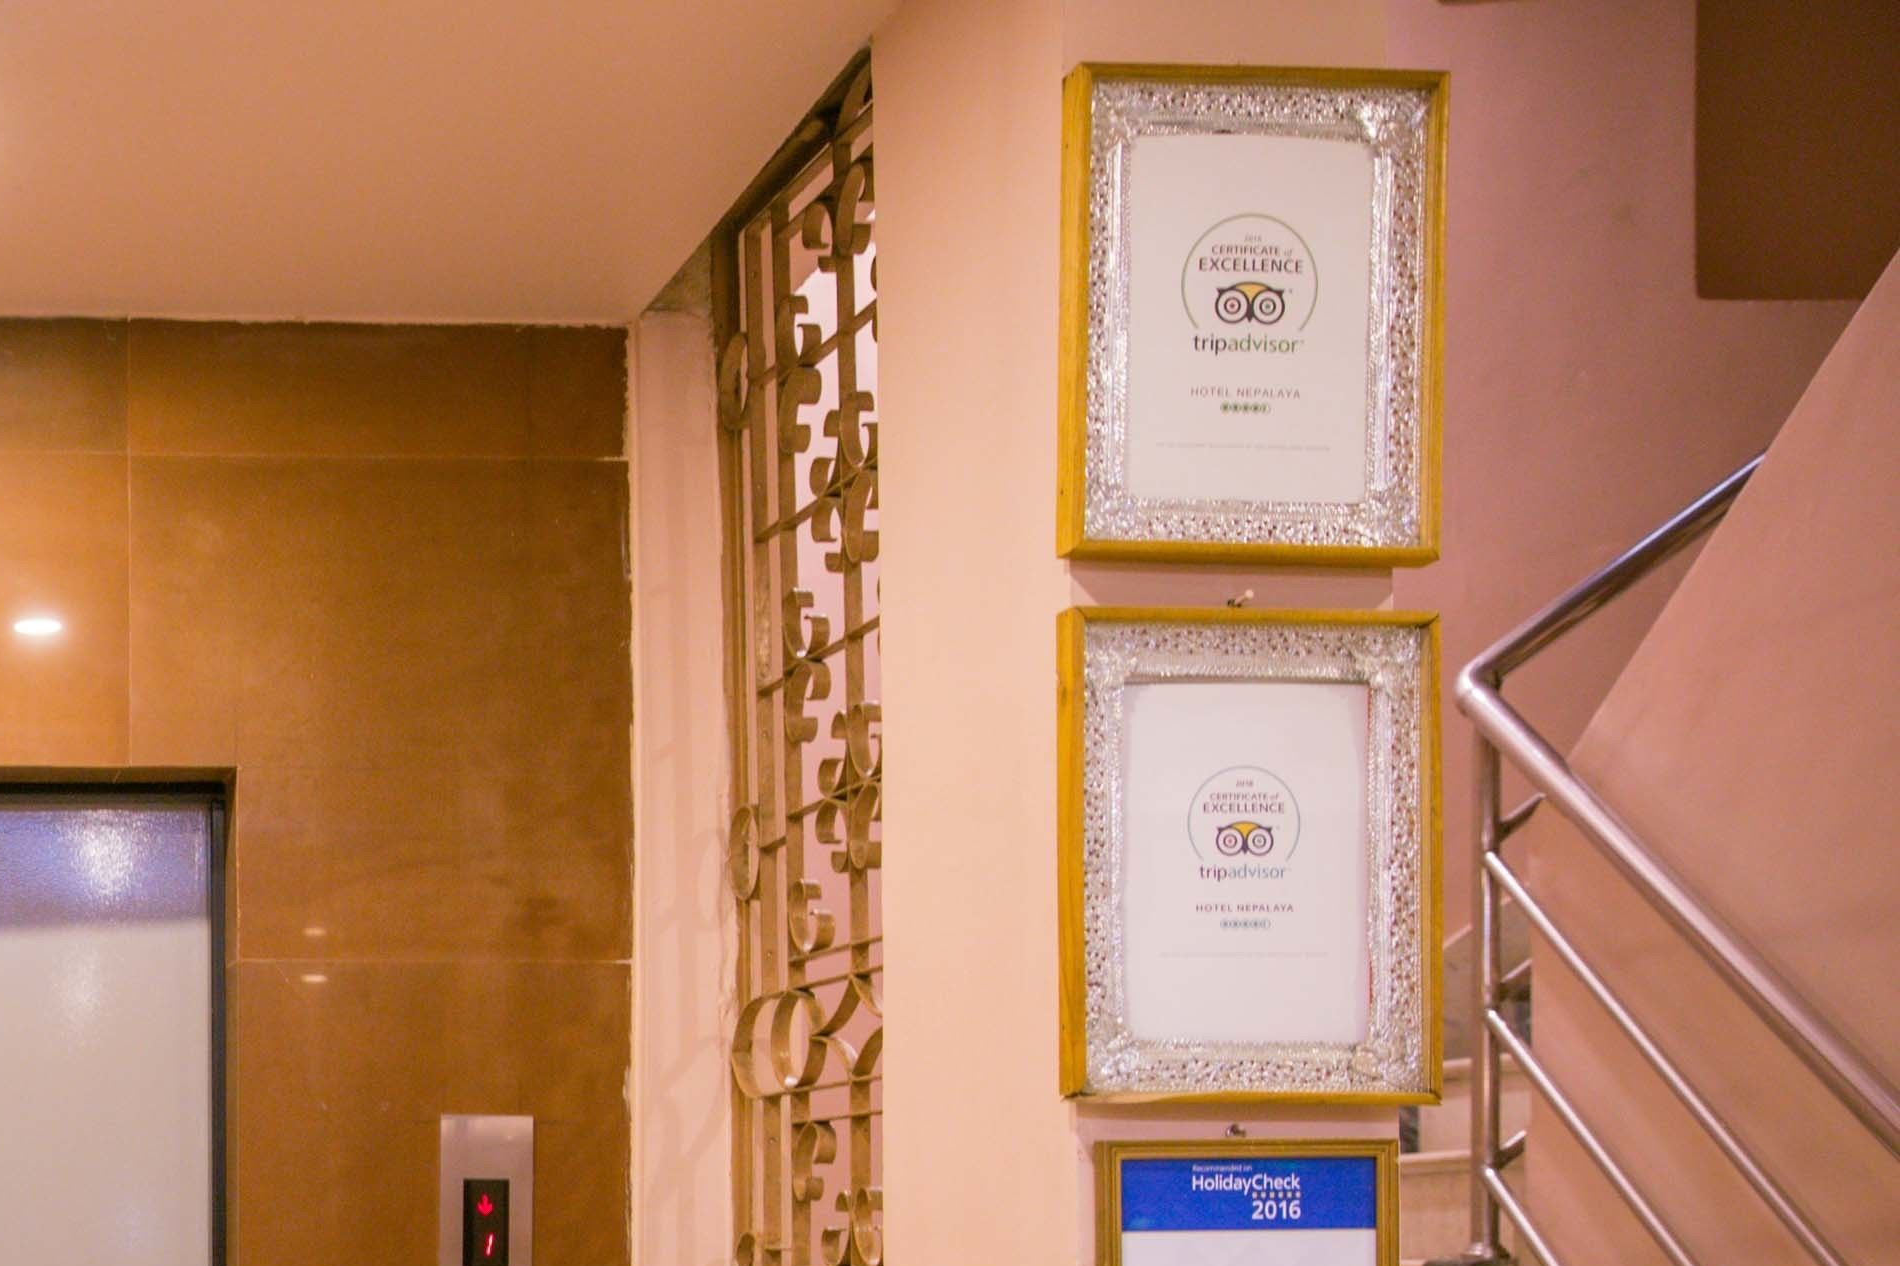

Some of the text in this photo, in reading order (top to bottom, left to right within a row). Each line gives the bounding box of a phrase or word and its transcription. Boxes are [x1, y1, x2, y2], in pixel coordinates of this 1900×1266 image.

[1211, 244, 1280, 256] CERTIFICATE
[1198, 257, 1304, 274] EXCELLENCE
[1193, 332, 1299, 356] tripadvisor
[1190, 382, 1301, 399] HOTEL NEPALAYA
[1209, 791, 1267, 801] CERTIFICATE
[1203, 802, 1285, 815] EXCELLENCE
[1199, 863, 1285, 882] tripadvisor
[1195, 902, 1295, 913] HOTEL NEPALAYA
[1191, 1172, 1301, 1196] HolidayCheck
[1251, 1200, 1302, 1220] 2016
[483, 1232, 495, 1257] 1
